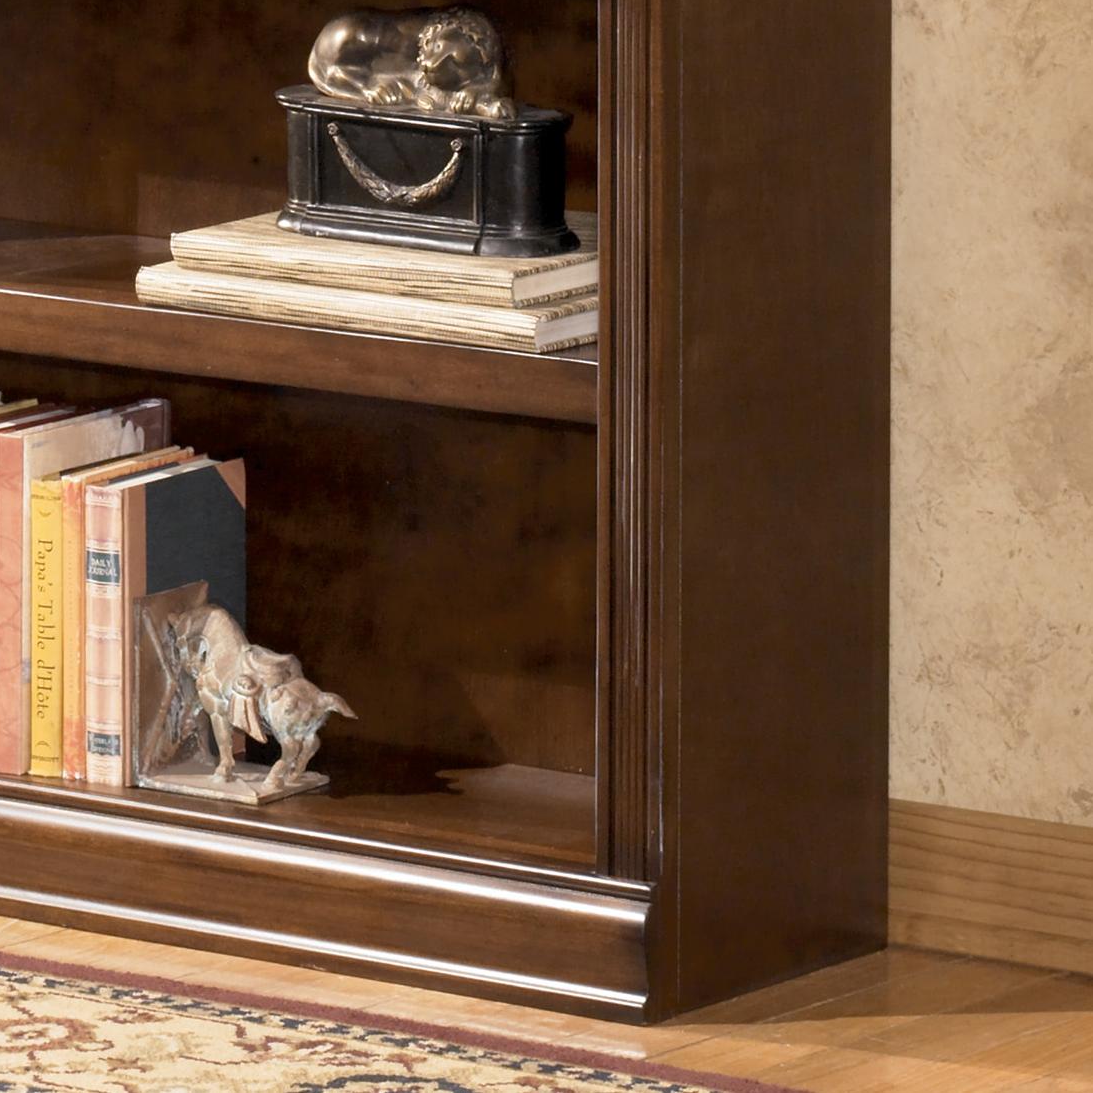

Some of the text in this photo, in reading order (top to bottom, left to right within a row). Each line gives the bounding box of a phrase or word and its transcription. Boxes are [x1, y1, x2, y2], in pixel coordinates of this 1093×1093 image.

[35, 539, 56, 719] Papa's Table d'Hôte
